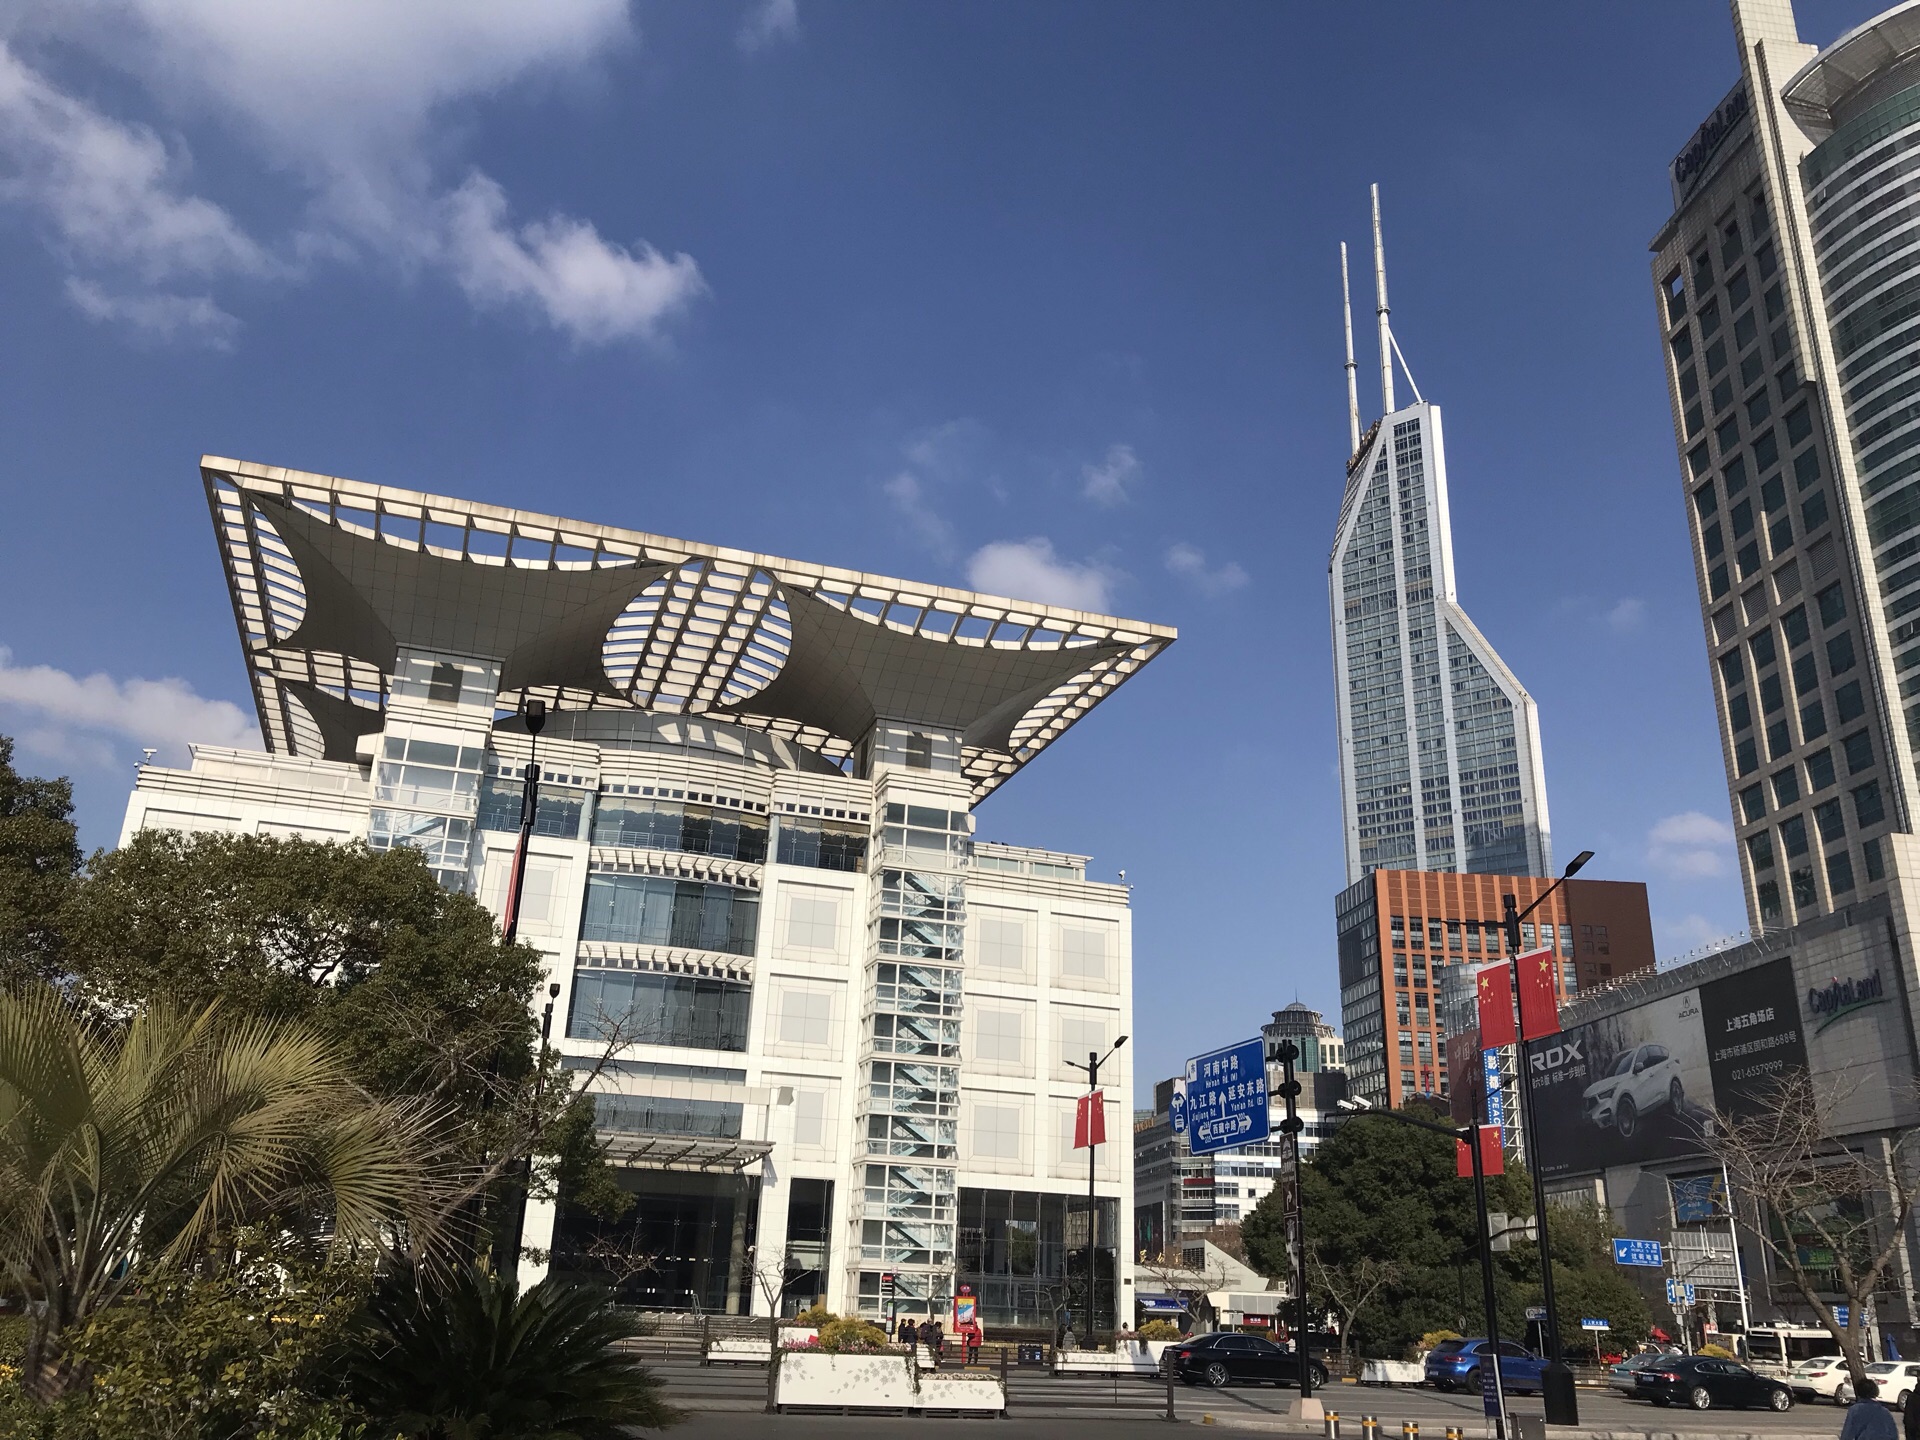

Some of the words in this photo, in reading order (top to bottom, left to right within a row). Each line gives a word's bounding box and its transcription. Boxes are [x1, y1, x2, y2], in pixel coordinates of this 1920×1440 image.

[1808, 969, 1883, 1017] CapitaLand
[1678, 1007, 1699, 1018] ACURA
[1726, 1007, 1775, 1032] 上海五角场店
[1530, 1040, 1584, 1074] RDX
[1714, 1030, 1797, 1062] 上海市杨浦区国和路688号
[1203, 1055, 1239, 1078] 河南中路
[1487, 1055, 1500, 1090] 影都
[1732, 1060, 1783, 1081] 021-65579999
[1190, 1091, 1216, 1110] 九江路
[1228, 1077, 1264, 1102] 延安东路
[1213, 1120, 1236, 1134] 西藏中路
